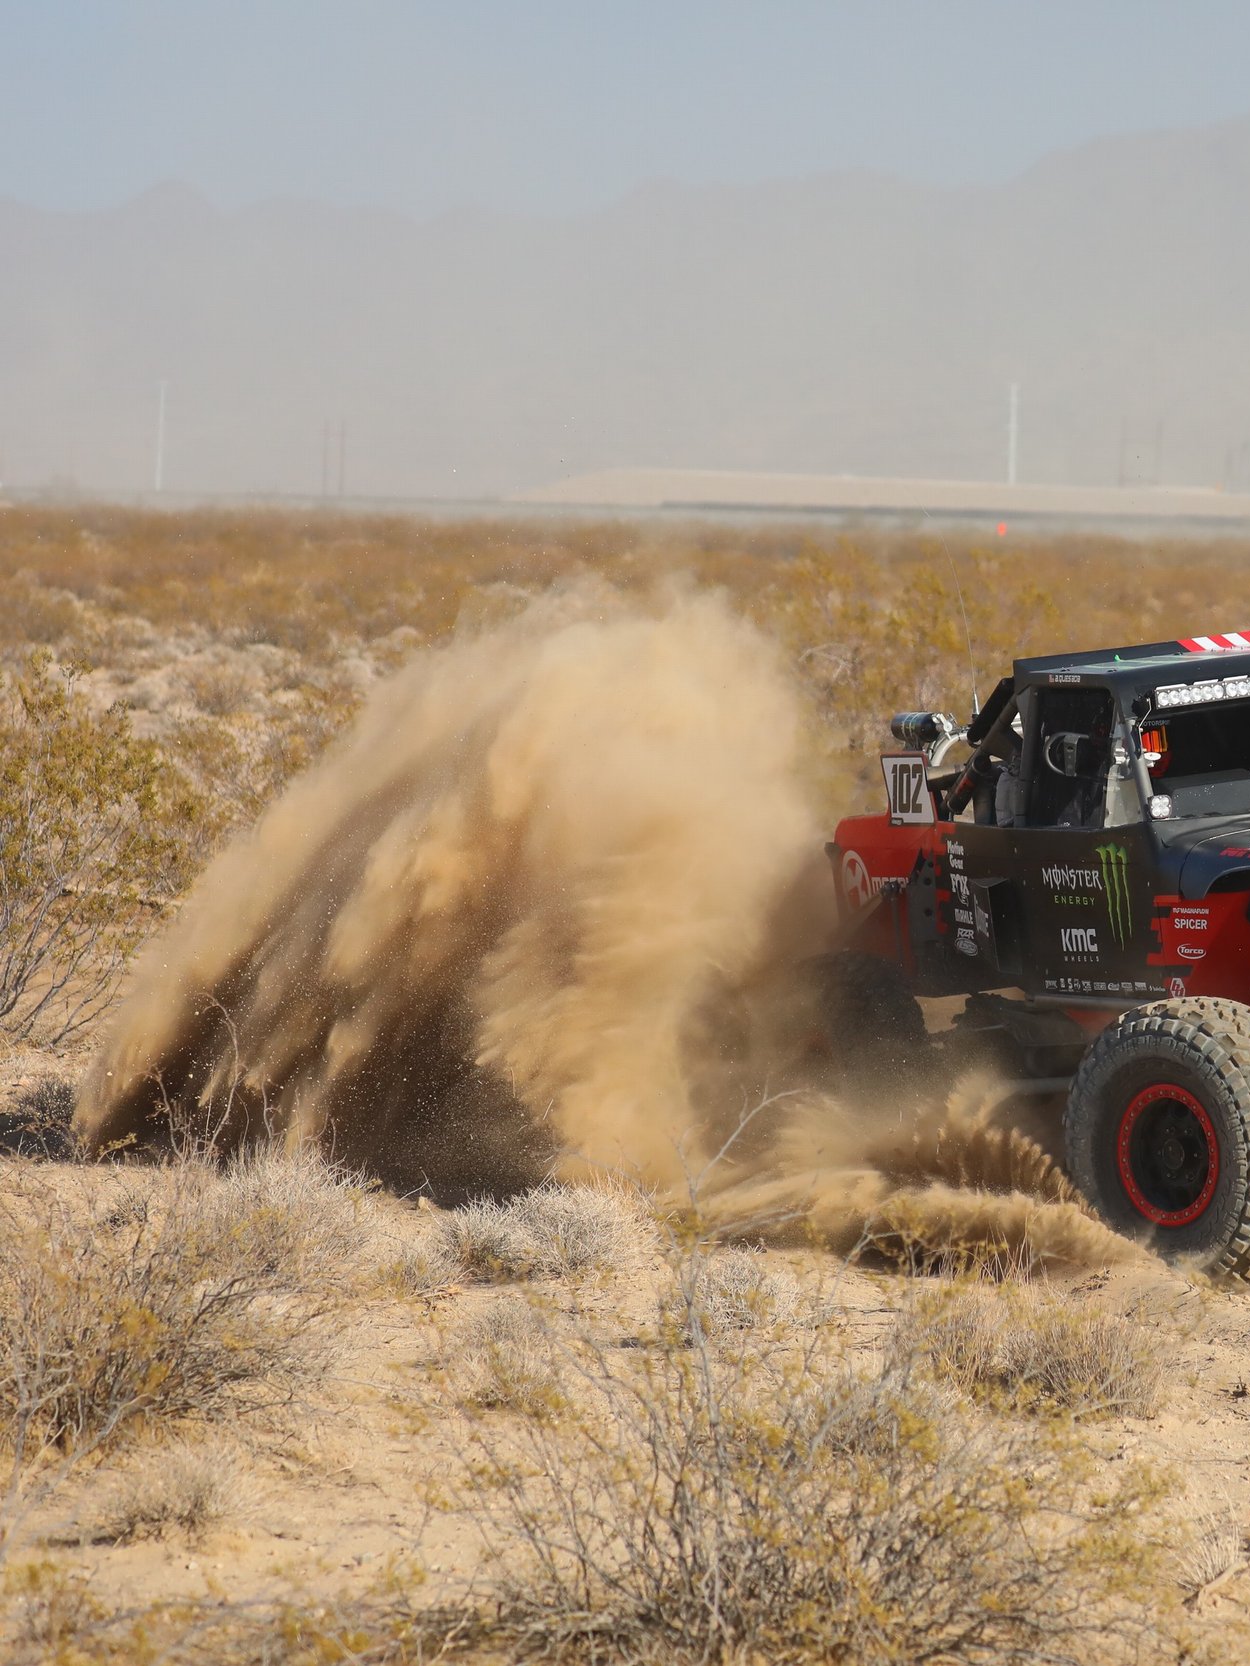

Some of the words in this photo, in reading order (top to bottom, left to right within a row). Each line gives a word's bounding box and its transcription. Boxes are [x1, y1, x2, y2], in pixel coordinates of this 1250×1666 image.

[891, 764, 923, 814] 102
[1054, 894, 1095, 906] ENERGY
[1174, 918, 1208, 930] SPICER
[1060, 928, 1098, 952] KMC
[1181, 946, 1204, 954] Torco
